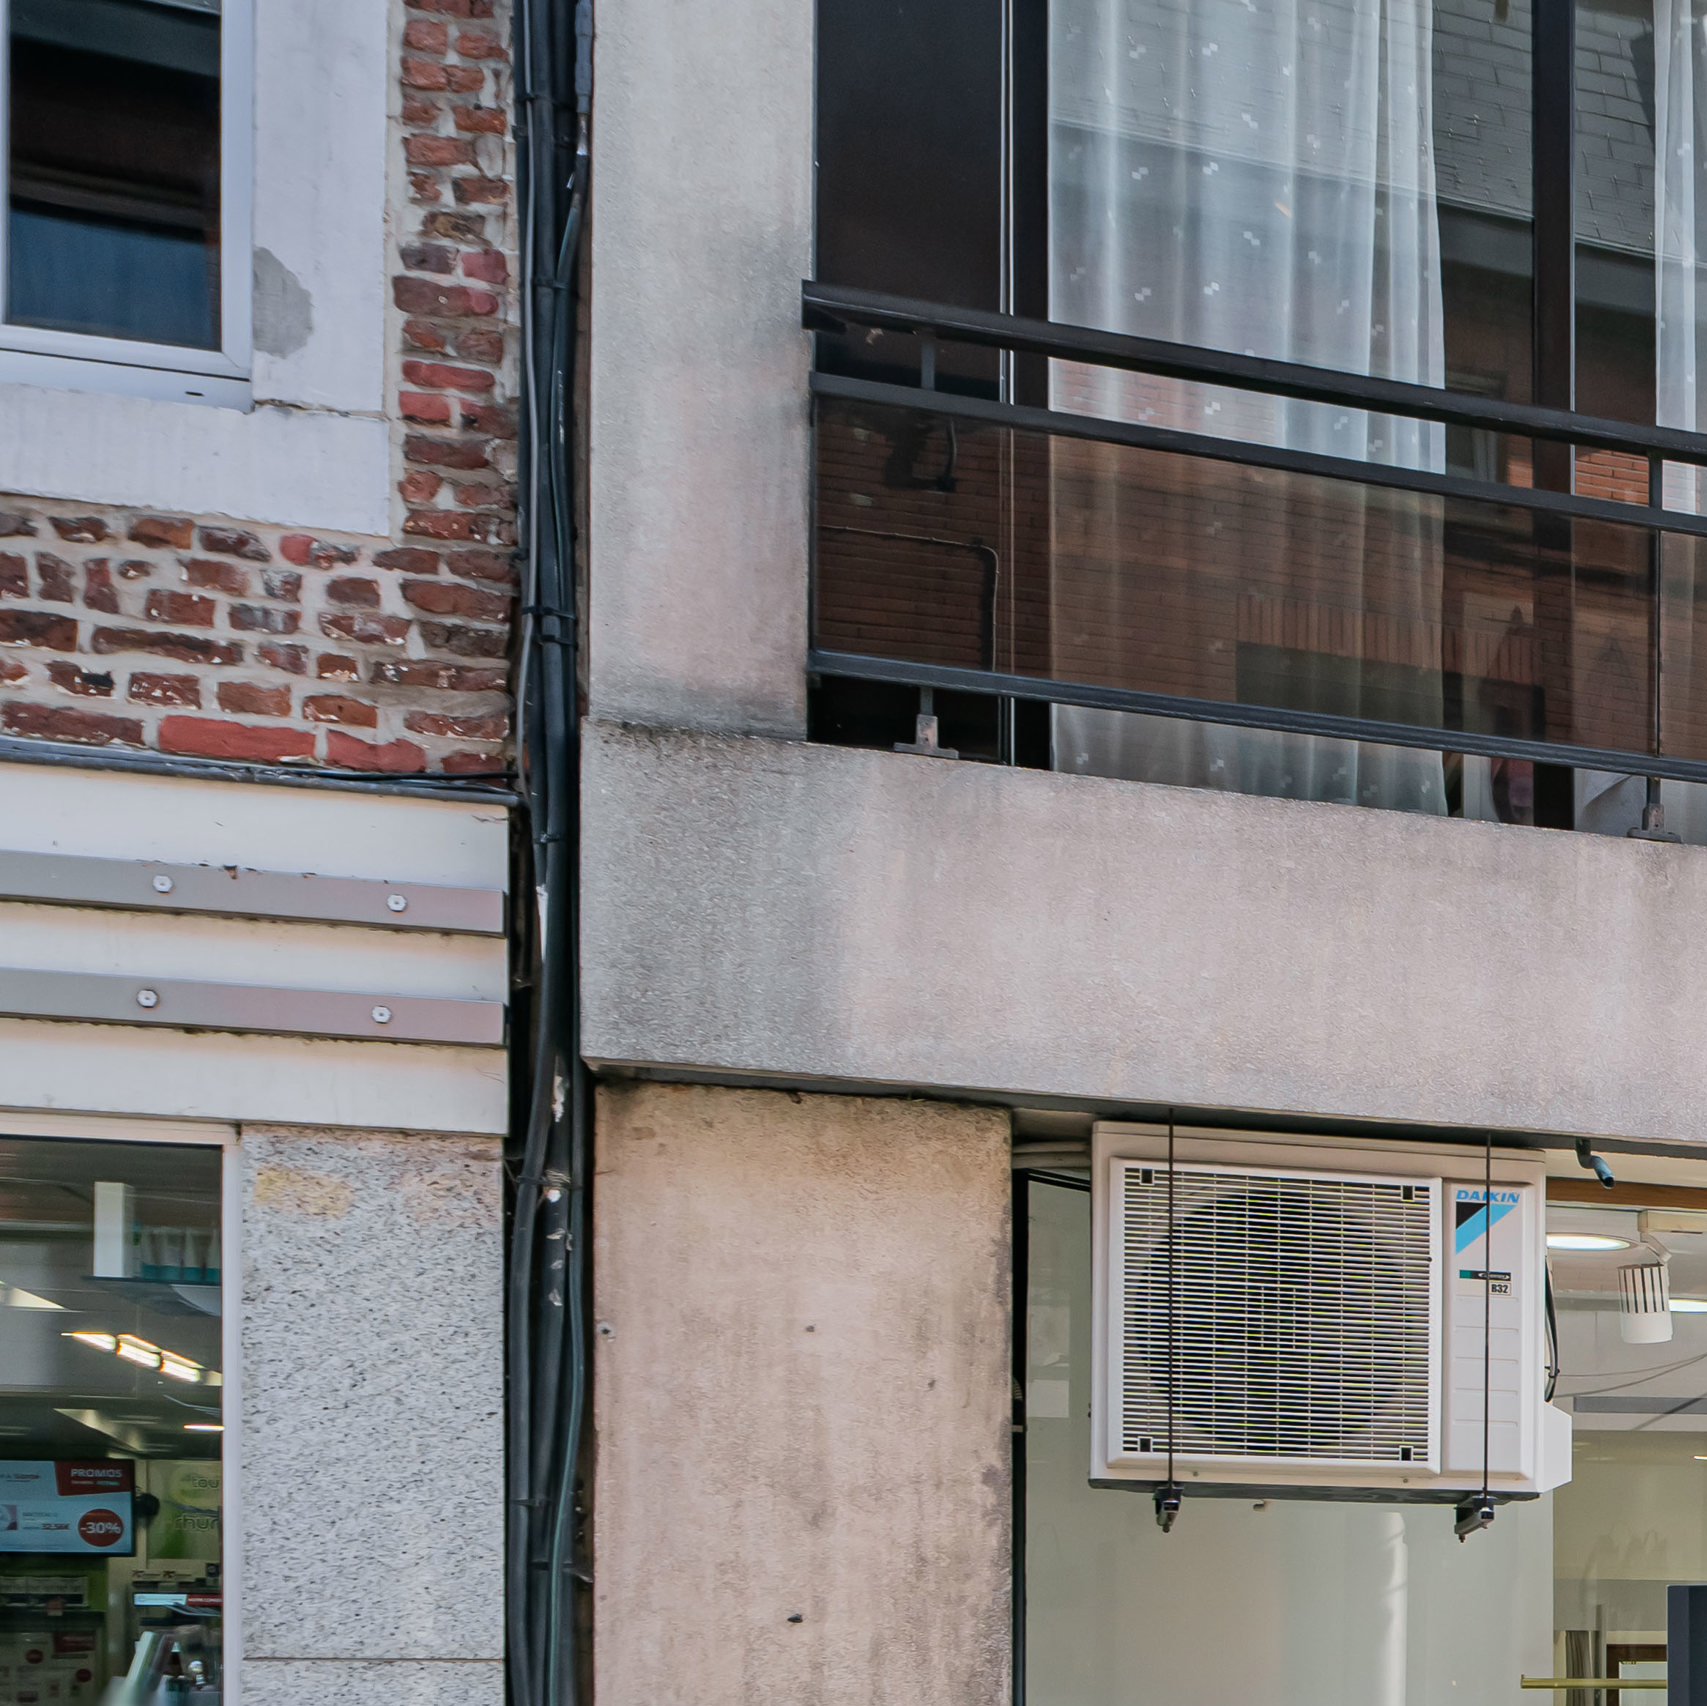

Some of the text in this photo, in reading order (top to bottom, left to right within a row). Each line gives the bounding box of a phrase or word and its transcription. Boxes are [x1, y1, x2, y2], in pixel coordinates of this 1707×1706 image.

[1456, 1190, 1520, 1203] DAIKIN
[71, 1468, 123, 1478] PROMOS
[80, 1522, 122, 1534] -30%
